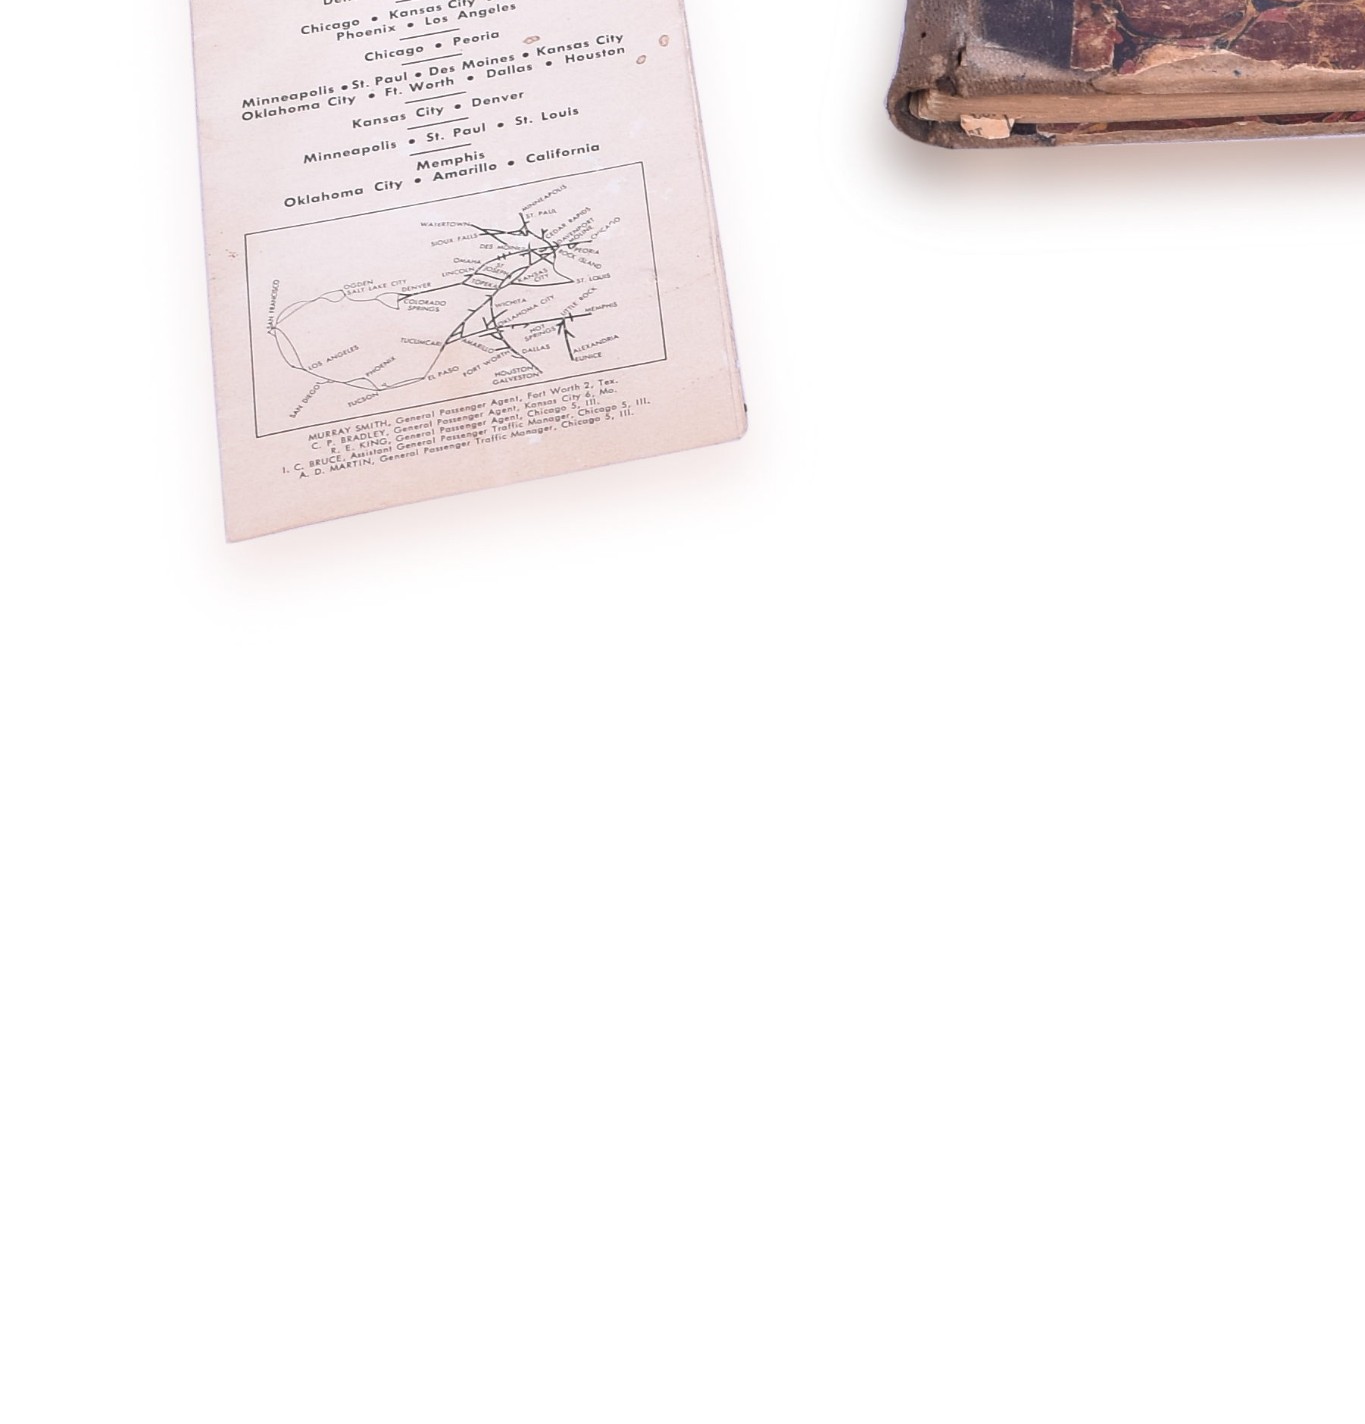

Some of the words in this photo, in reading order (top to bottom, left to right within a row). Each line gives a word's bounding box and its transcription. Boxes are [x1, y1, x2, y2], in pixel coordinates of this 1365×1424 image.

[299, 18, 360, 35] Chicago
[388, 3, 442, 20] Kansas
[335, 23, 396, 41] Phoenix
[424, 15, 448, 26] Los
[456, 2, 516, 20] Angeles
[363, 45, 424, 62] Chicago
[451, 30, 500, 46] Peoria
[240, 101, 320, 121] Oklahoma
[326, 95, 356, 107] City
[384, 86, 403, 97] Ft.
[407, 75, 454, 92] Worth
[485, 63, 533, 79] Dallas
[563, 46, 625, 64] Houston
[241, 84, 335, 109] Minneapolis
[350, 78, 370, 90] St.
[373, 70, 408, 86] Paul
[427, 64, 455, 77] Des
[461, 53, 515, 71] Moines
[535, 40, 590, 57] Kansas
[594, 33, 624, 45] City
[351, 112, 407, 129] Kansas
[414, 105, 444, 118] City
[470, 90, 524, 108] Denver
[302, 139, 397, 164] Minneapolis
[425, 131, 445, 143] St.
[452, 121, 486, 138] Paul
[514, 114, 533, 126] St.
[540, 106, 579, 121] Louis
[282, 187, 364, 208] Oklahoma
[373, 179, 403, 192] City
[431, 161, 497, 182] Amarillo
[524, 142, 600, 164] California
[415, 149, 485, 171] Memphis
[583, 301, 619, 315] MEMPHIS
[521, 343, 551, 356] DALLAS
[307, 425, 351, 442] MURRAY
[354, 418, 392, 433] SMITH,
[394, 409, 435, 424] General
[438, 401, 487, 416] Passenger
[489, 394, 523, 407] Agent,
[526, 389, 546, 400] Fort
[548, 382, 581, 395] Worth
[582, 380, 594, 390] 2,
[596, 377, 619, 386] Tex.
